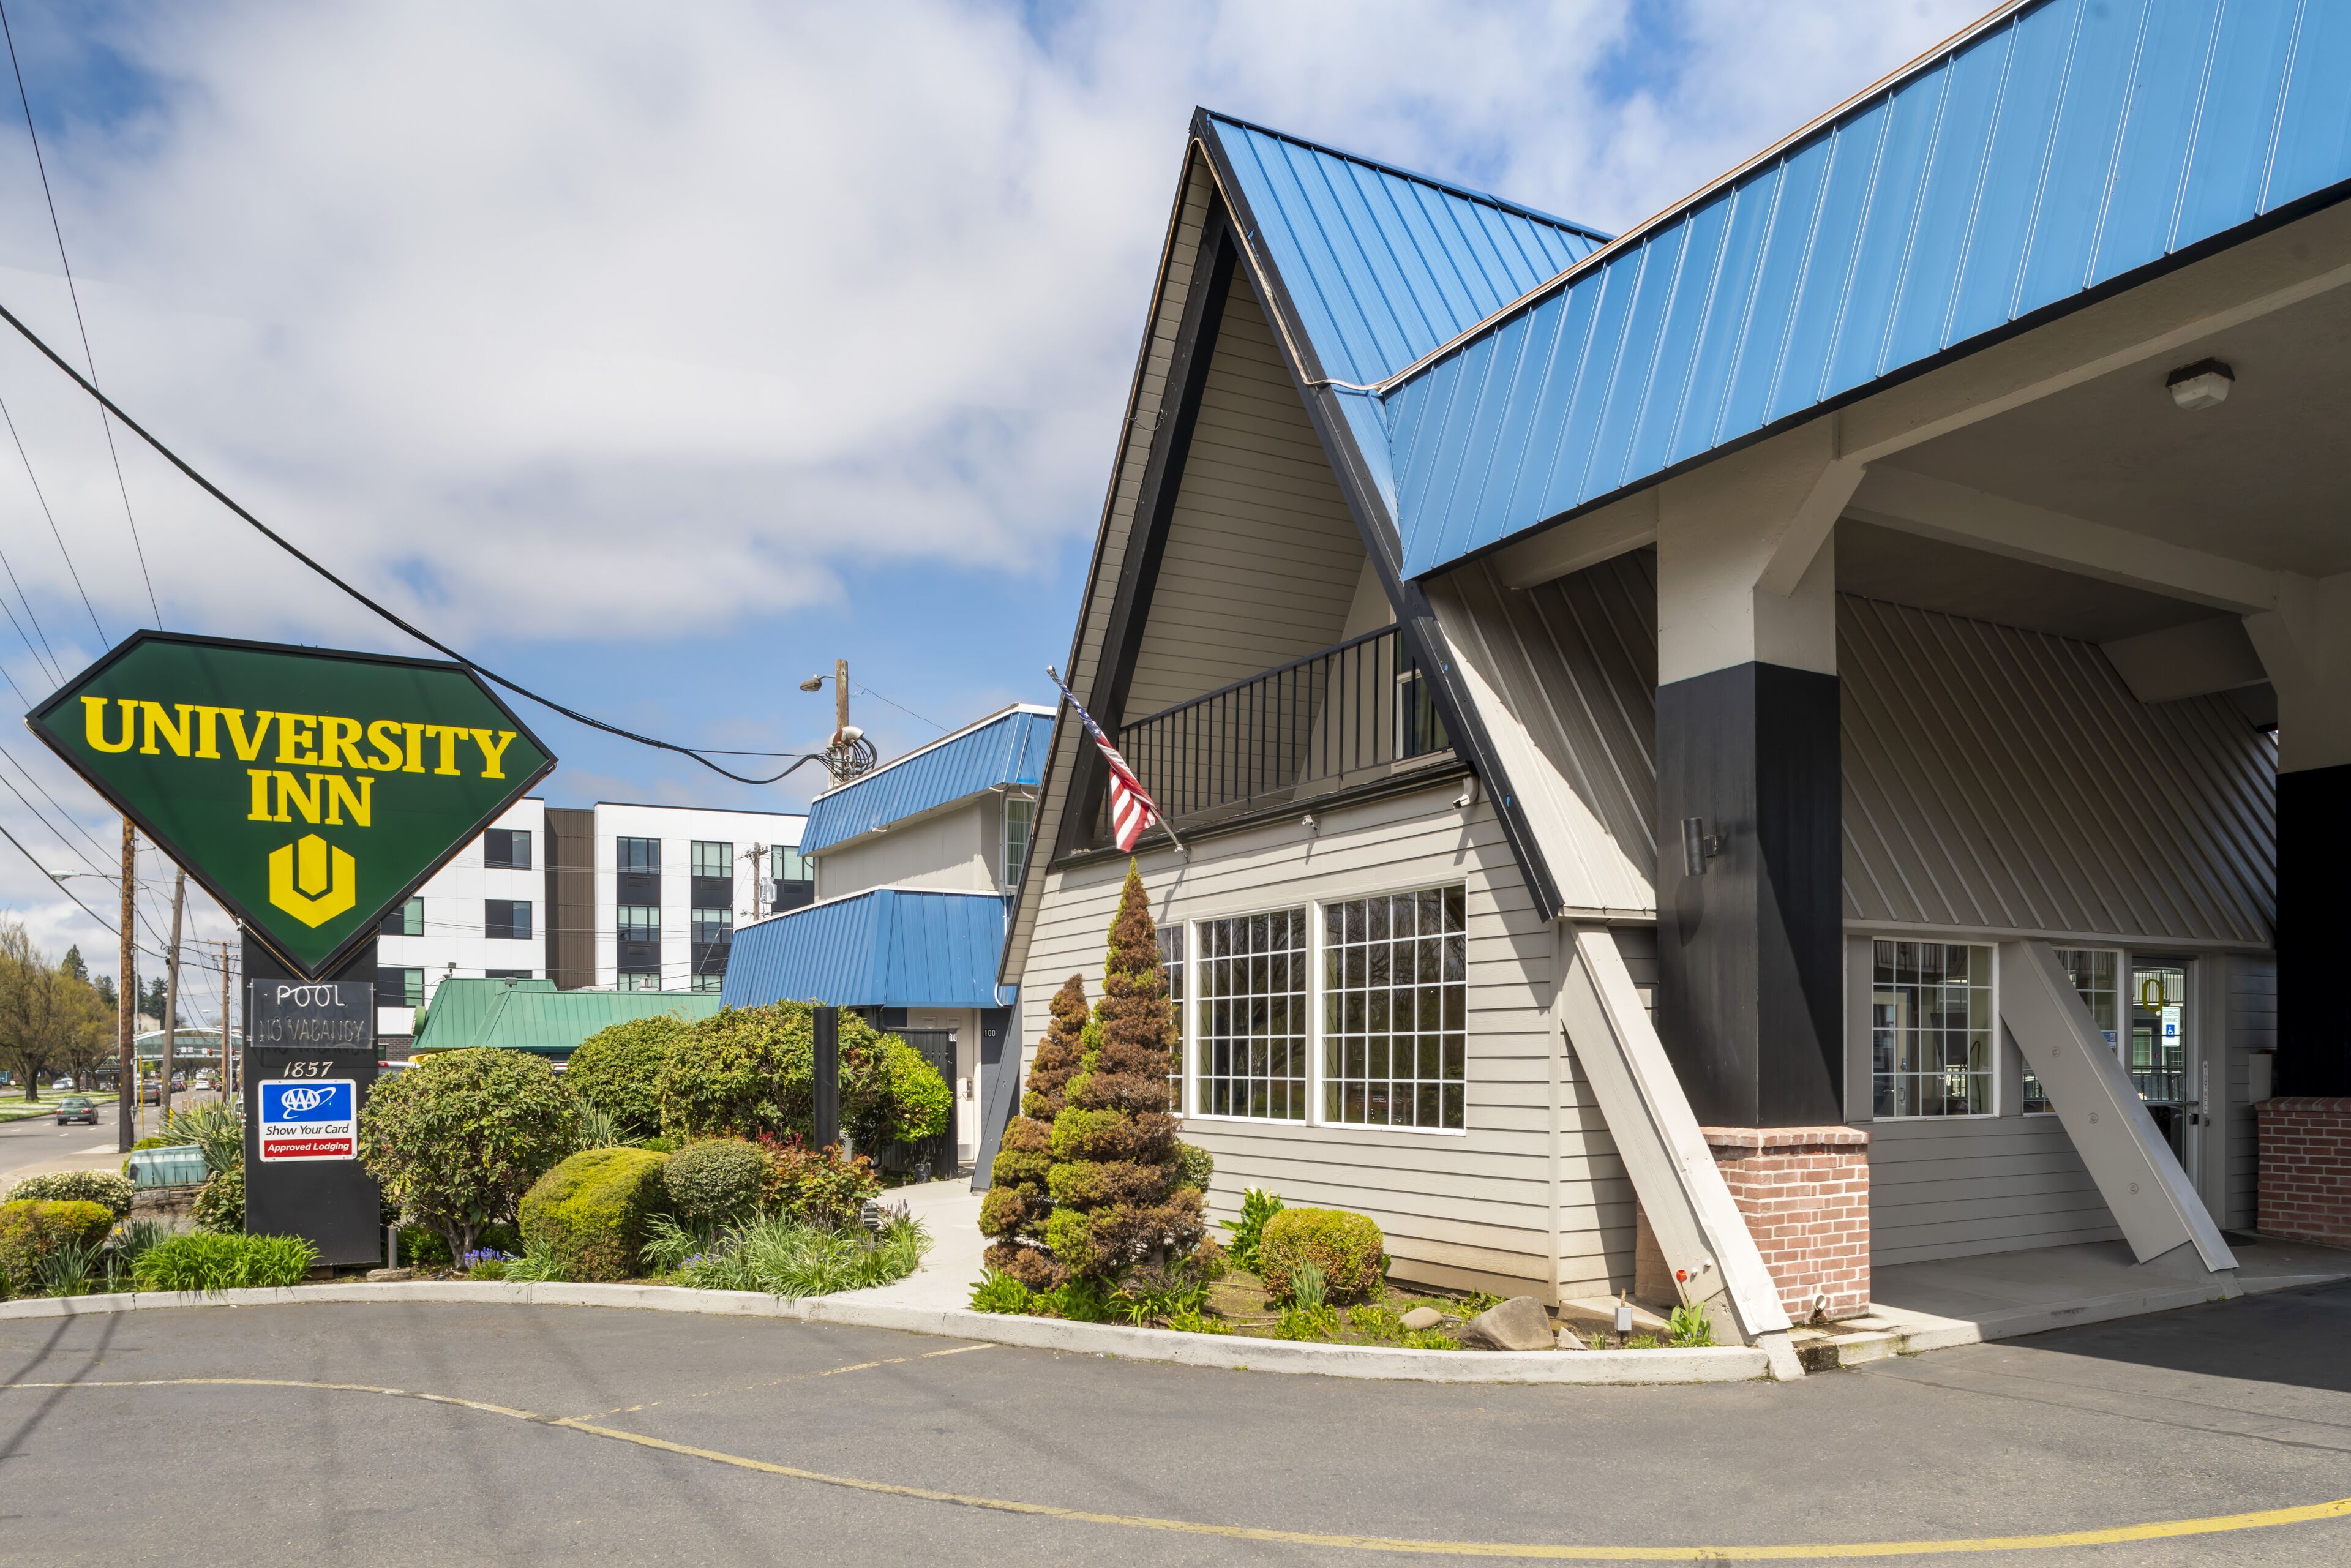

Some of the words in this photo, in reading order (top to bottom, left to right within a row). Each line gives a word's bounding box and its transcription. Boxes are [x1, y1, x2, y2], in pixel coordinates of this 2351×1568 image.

[81, 696, 517, 779] UNIVERSITY
[247, 769, 375, 827] INN
[277, 985, 346, 1007] POOL
[260, 1019, 283, 1041] NO
[288, 1019, 364, 1041] VACANCY
[284, 1061, 334, 1078] 1857
[286, 1089, 316, 1109] AAA
[266, 1126, 297, 1136] Show
[300, 1125, 323, 1135] Your
[325, 1123, 350, 1134] Card
[268, 1142, 312, 1153] Approved
[313, 1142, 350, 1152] Lodging
